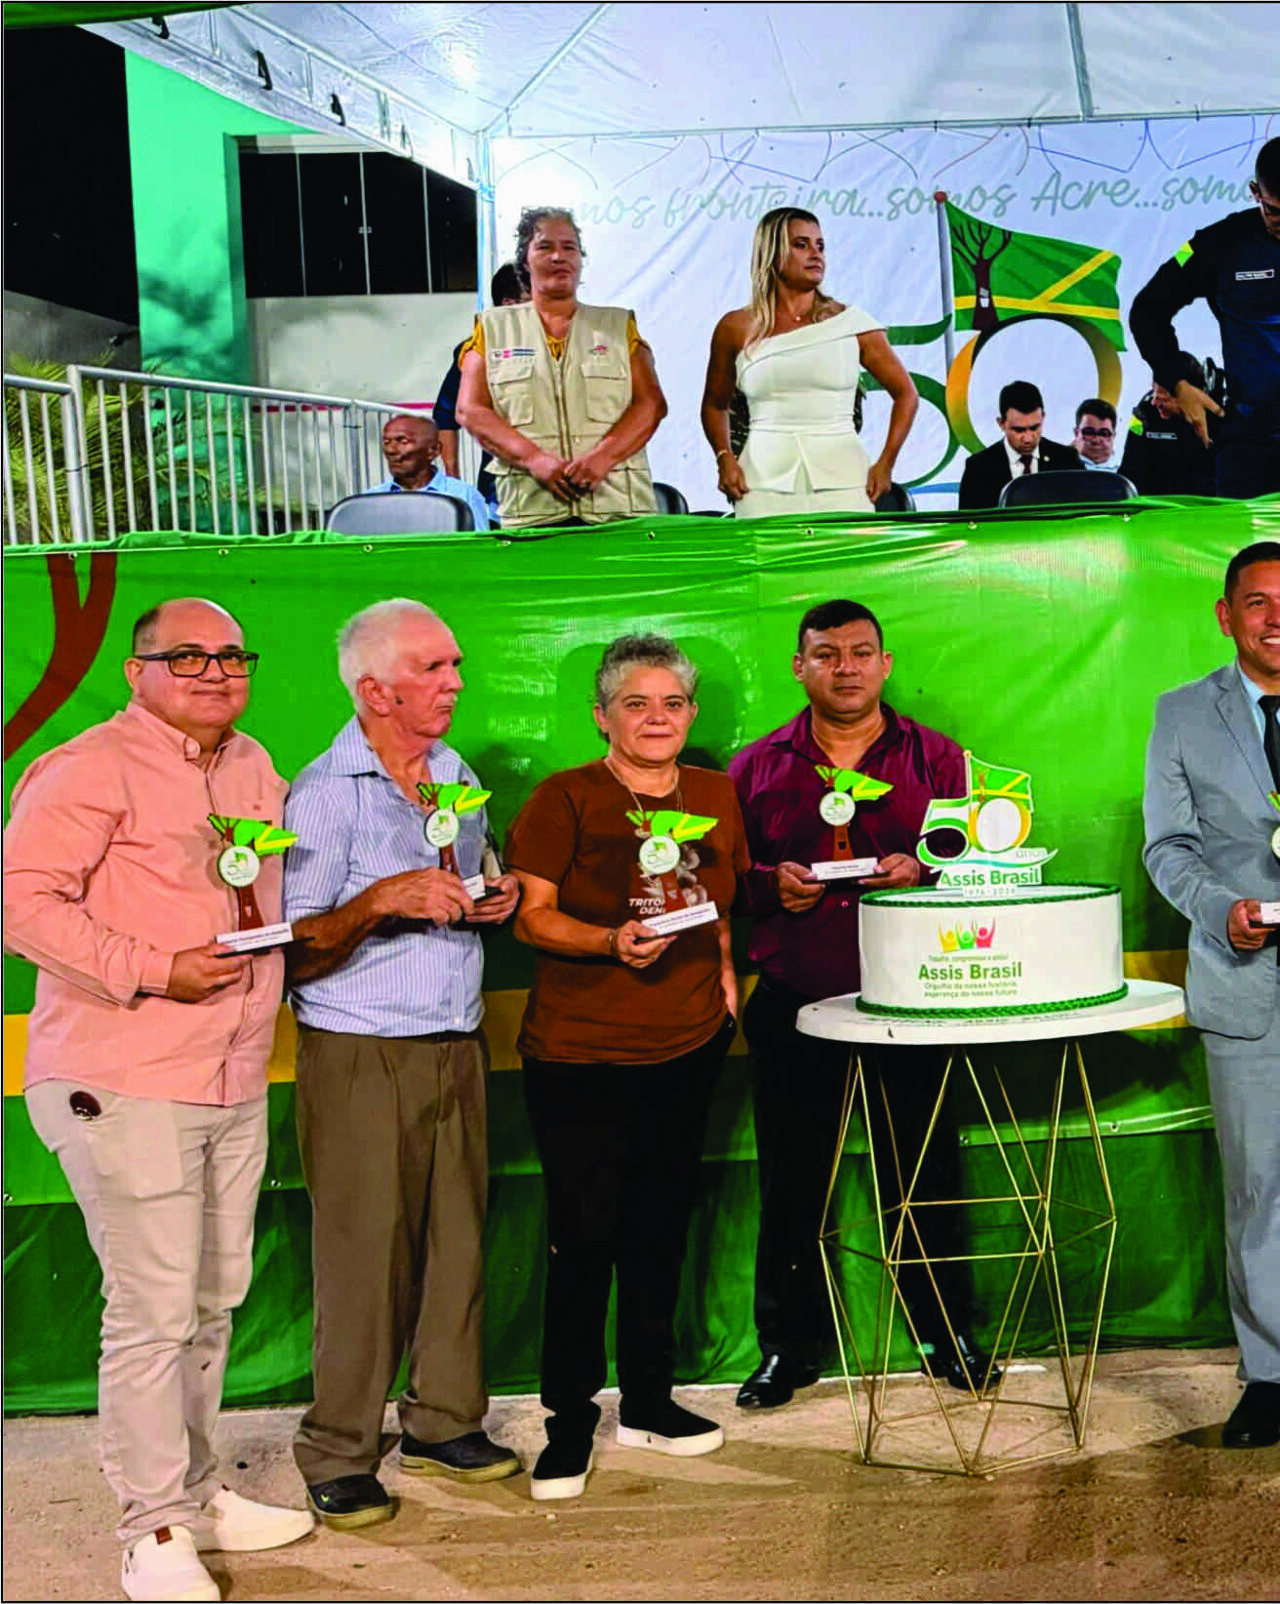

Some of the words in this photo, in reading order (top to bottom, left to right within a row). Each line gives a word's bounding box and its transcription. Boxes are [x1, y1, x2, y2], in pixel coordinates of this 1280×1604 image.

[940, 869, 985, 886] Assis
[990, 867, 1039, 885] Brasil
[918, 963, 963, 981] Assis
[969, 961, 1023, 979] Brasil
